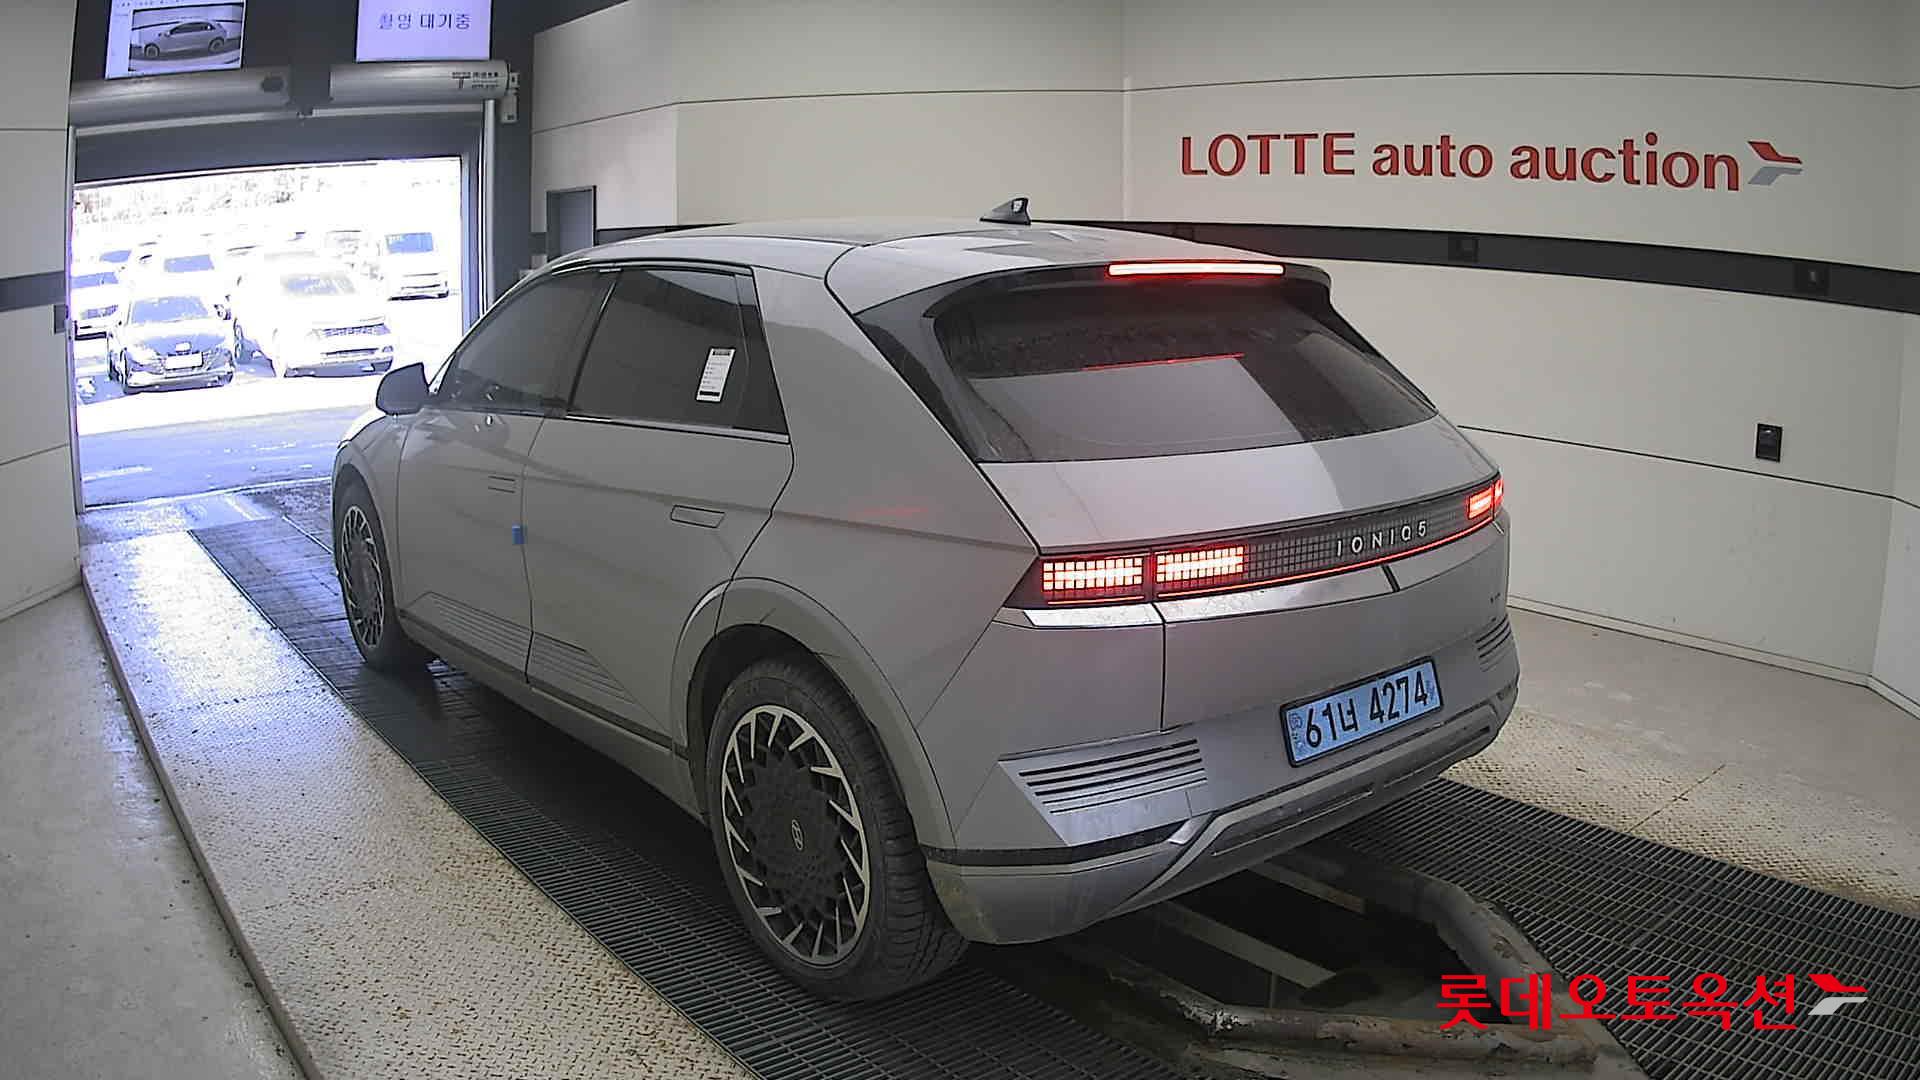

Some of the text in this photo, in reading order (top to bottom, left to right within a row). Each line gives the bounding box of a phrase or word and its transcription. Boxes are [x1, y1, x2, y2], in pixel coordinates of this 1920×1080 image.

[420, 13, 470, 30] 대기중
[1181, 132, 1740, 192] LOTTE auto auction
[1306, 671, 1428, 748] 61너 4274
